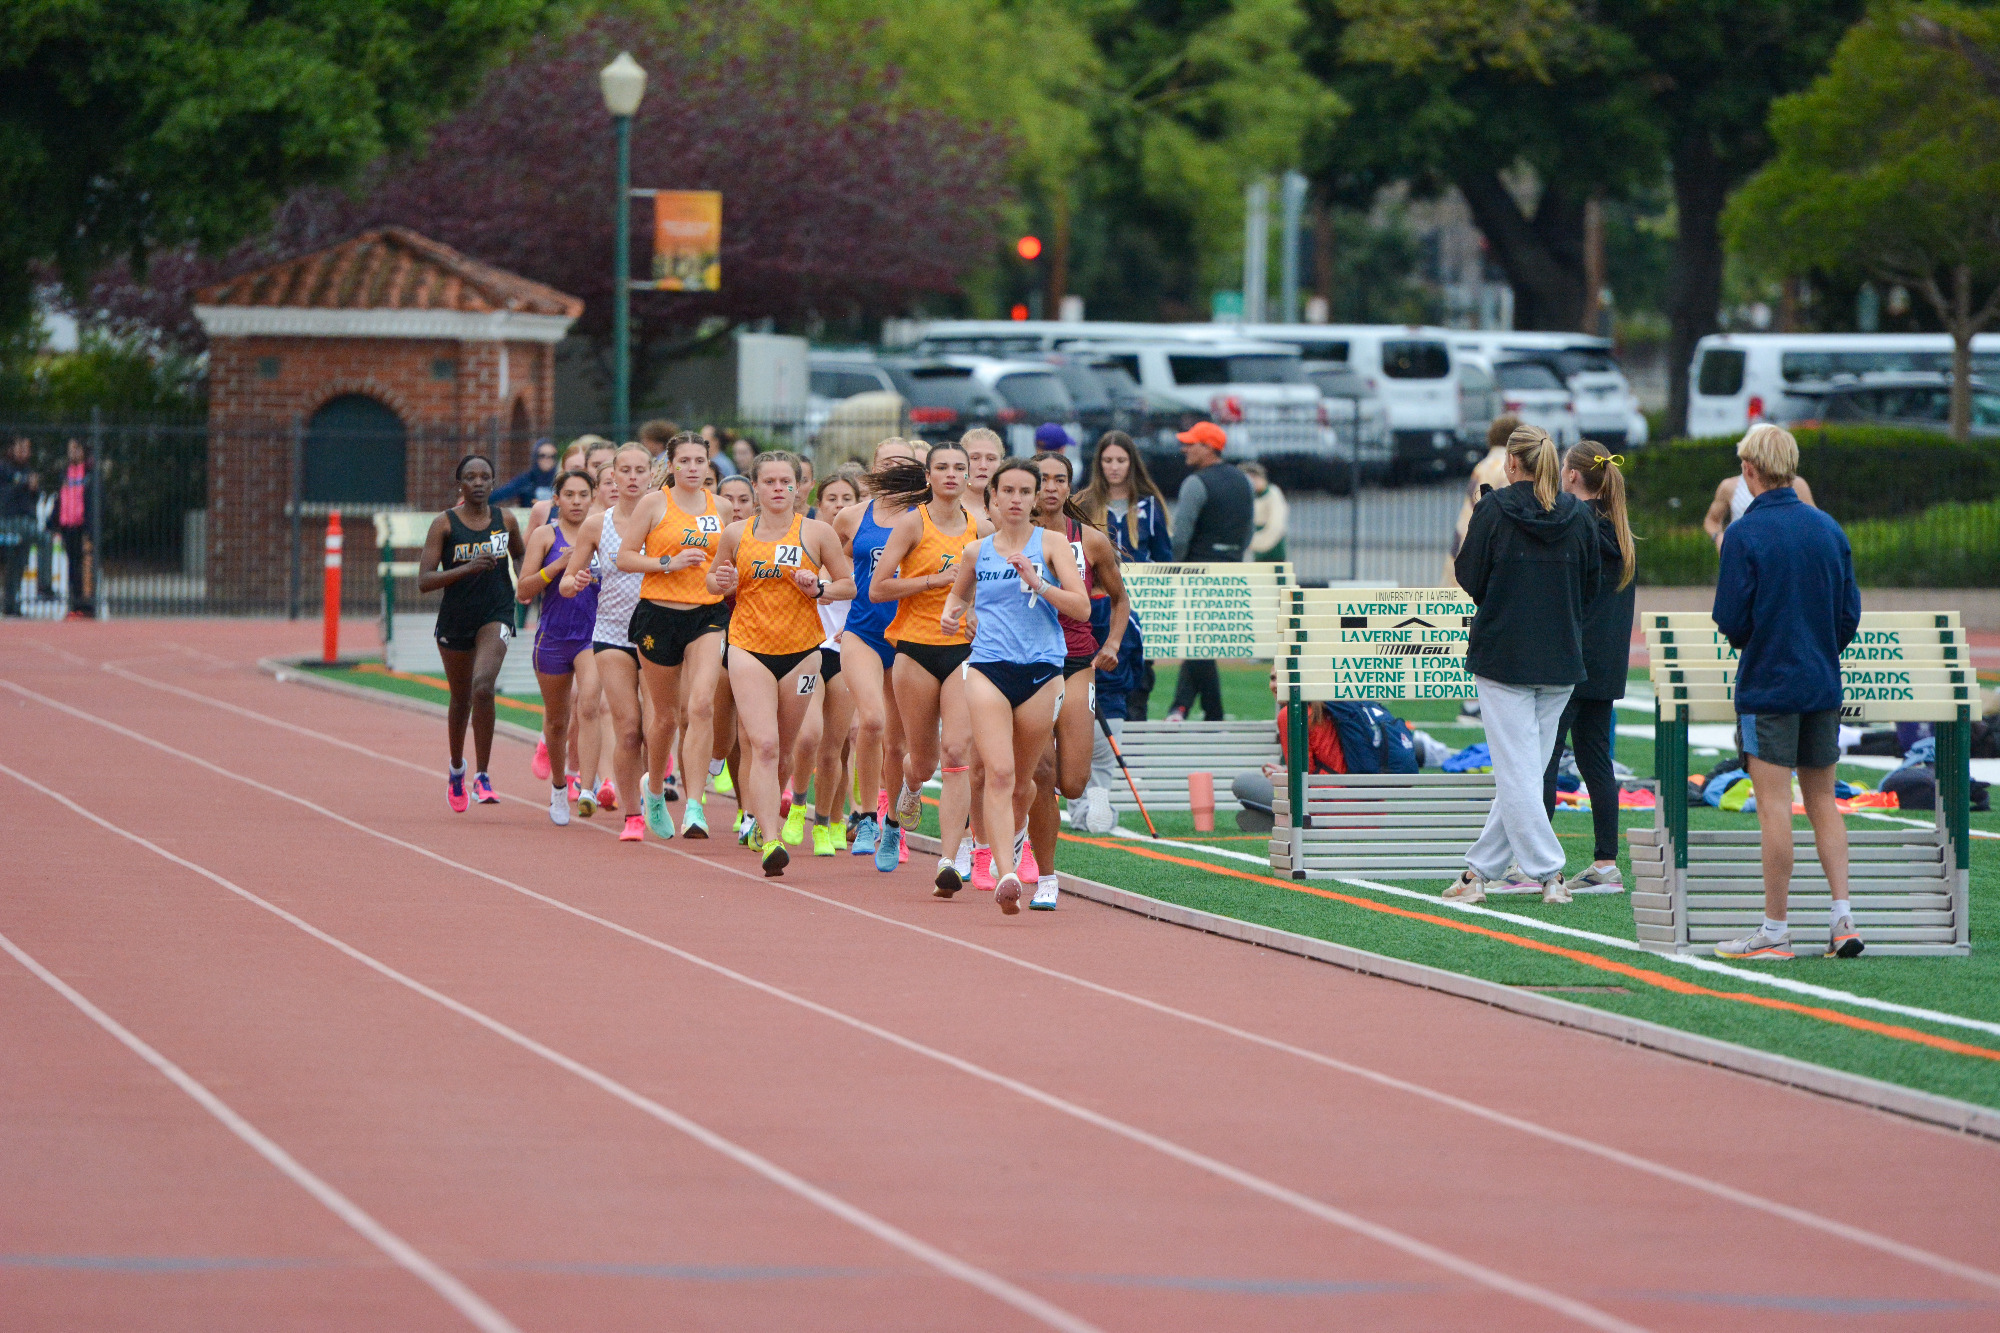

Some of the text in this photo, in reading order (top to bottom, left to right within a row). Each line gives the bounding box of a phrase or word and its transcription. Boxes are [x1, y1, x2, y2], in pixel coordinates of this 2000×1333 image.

[699, 516, 718, 532] 23
[494, 534, 507, 552] 26
[680, 528, 710, 548] Tech
[777, 545, 798, 565] 24
[751, 560, 783, 580] Tech
[976, 570, 1001, 582] SAN
[1181, 577, 1247, 586] LEOPARDS
[1185, 588, 1252, 598] LEOPARDS
[1375, 591, 1413, 601] UNIVERSITY
[1183, 600, 1250, 609] LEOPARDS
[1417, 603, 1480, 615] LEOPAR
[1186, 611, 1254, 620] LEOPARDS
[1186, 622, 1253, 631] LEOPARDS
[1188, 634, 1255, 643] LEOPARDS
[1422, 630, 1469, 642] LEOPA
[1851, 631, 1900, 644] ARDS
[1145, 646, 1253, 658] ERNE LEOPARDS
[1421, 646, 1451, 655] GILL
[1840, 647, 1904, 660] PARDS
[1412, 657, 1467, 669] LEOPA
[1414, 671, 1474, 683] LEOPAR
[1840, 671, 1910, 684] OPARDS
[800, 675, 816, 694] 24
[1415, 684, 1478, 698] LEOPAR
[1841, 687, 1914, 700] OPARDS
[1840, 706, 1862, 717] ILL
